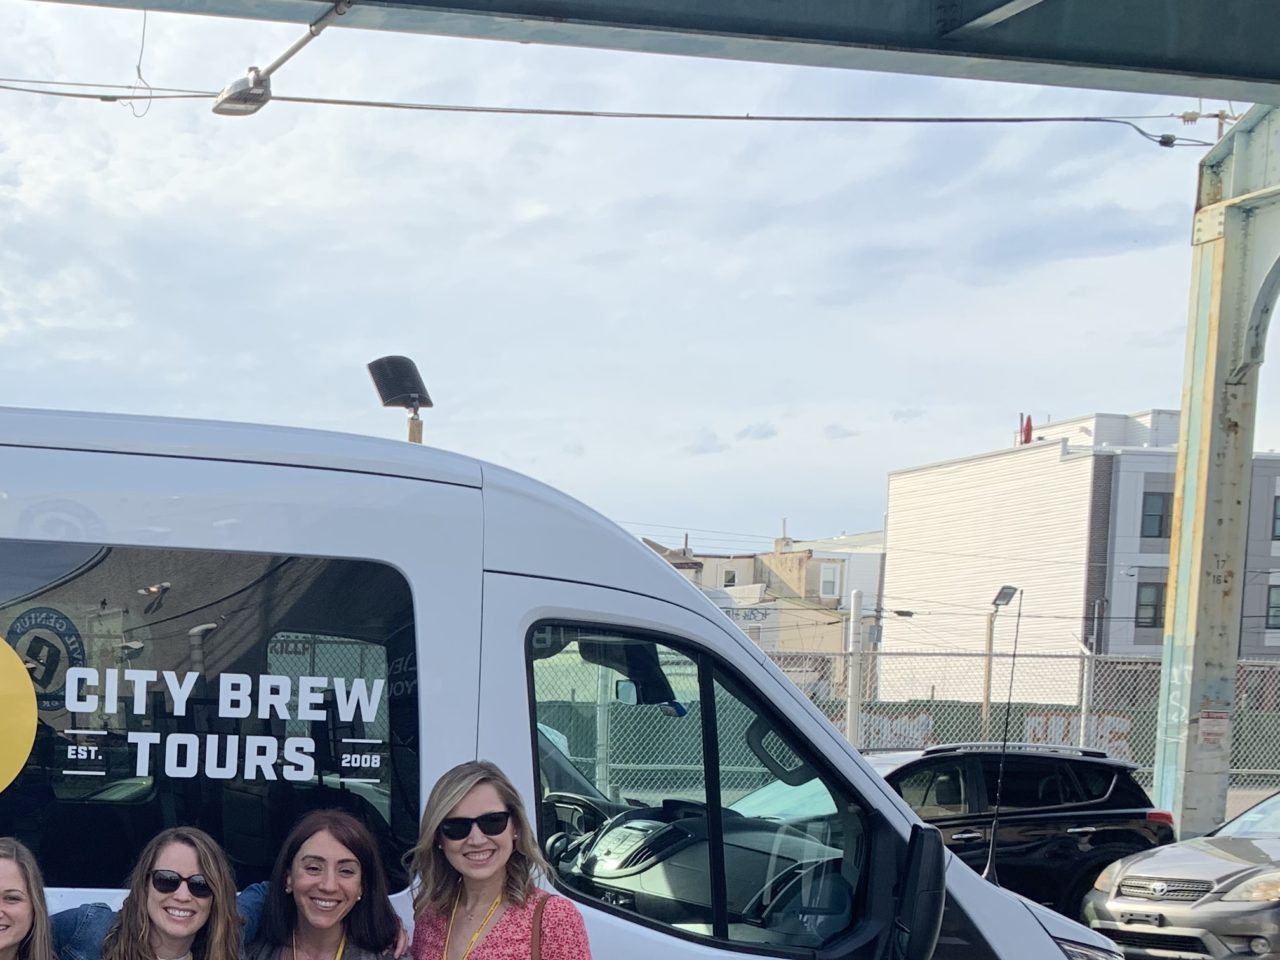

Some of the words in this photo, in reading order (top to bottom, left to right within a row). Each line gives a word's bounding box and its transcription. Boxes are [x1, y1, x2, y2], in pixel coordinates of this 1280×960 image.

[64, 666, 200, 717] CITY
[218, 672, 385, 723] BREW
[67, 745, 103, 760] EST.
[127, 731, 316, 782] TOURS
[341, 753, 381, 769] 2008
